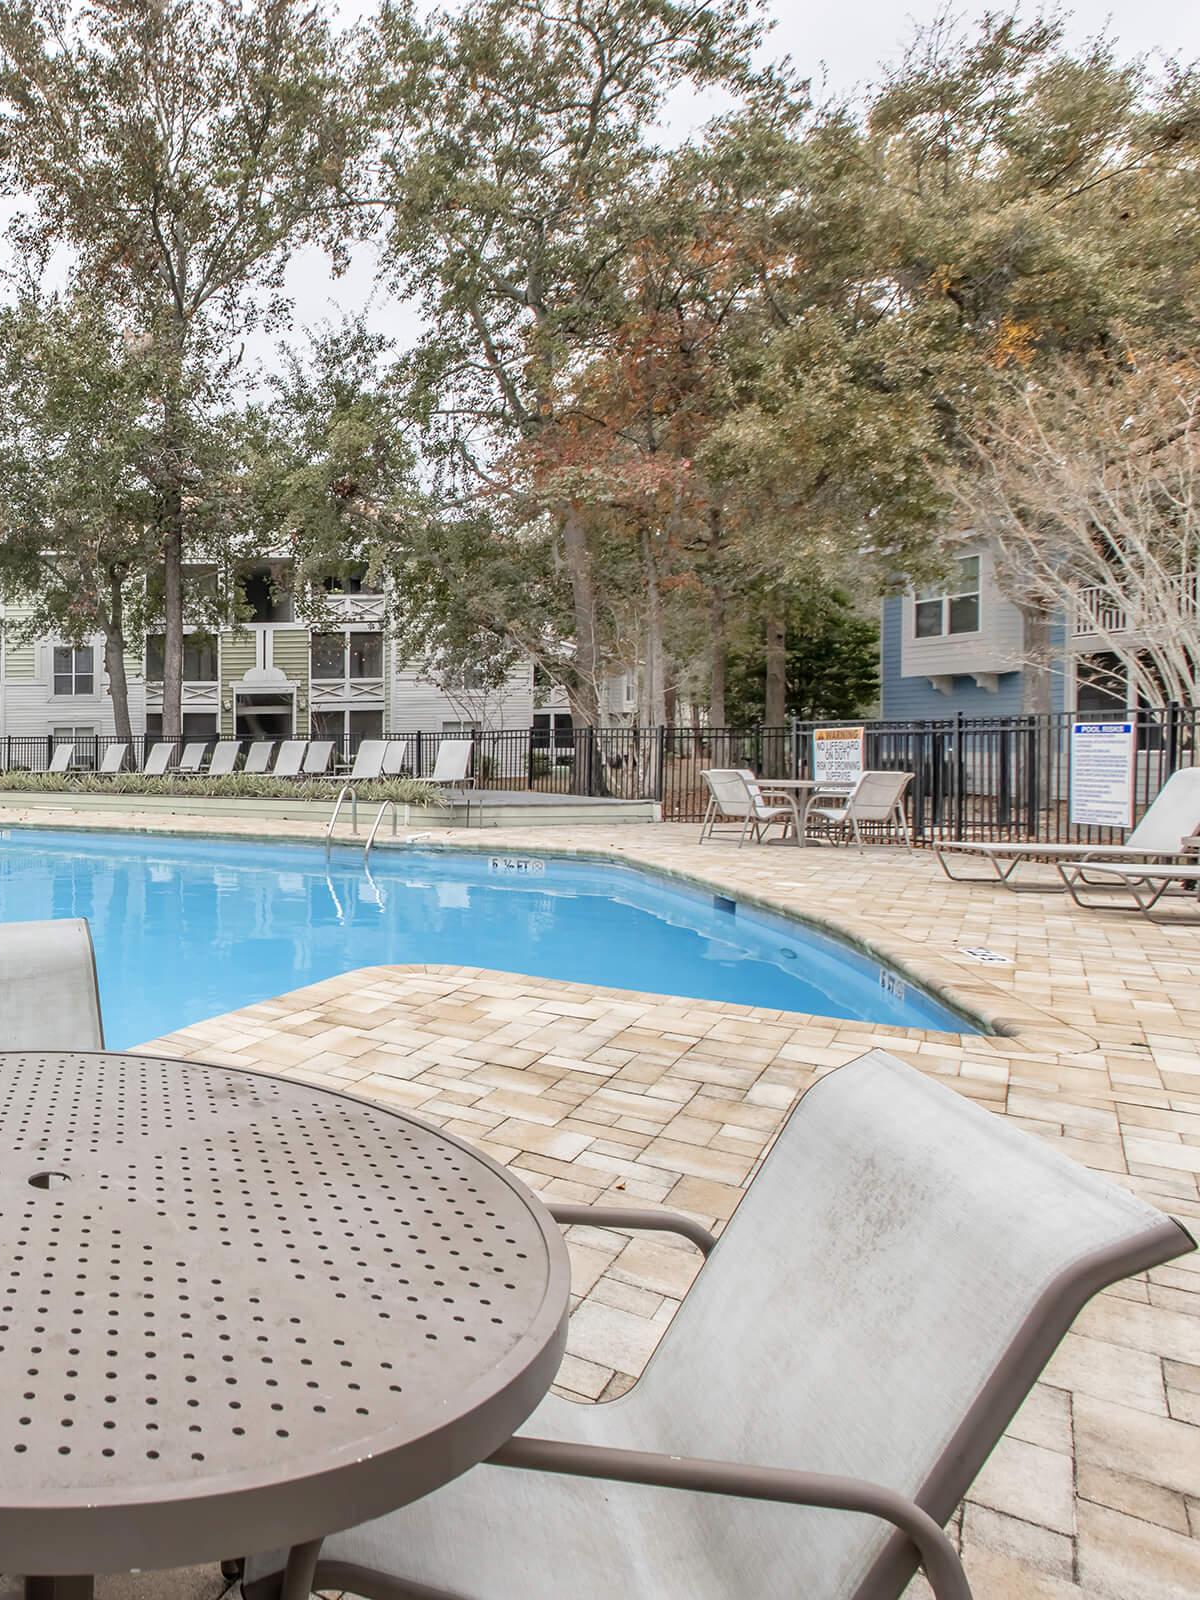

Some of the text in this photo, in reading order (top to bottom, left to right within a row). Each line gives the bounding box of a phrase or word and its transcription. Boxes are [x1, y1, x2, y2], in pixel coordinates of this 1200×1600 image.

[825, 730, 859, 740] WARNING
[1081, 726, 1100, 734] POOL
[816, 740, 860, 752] NO LIFEGUARD
[824, 751, 850, 760] ON DUTY
[816, 761, 860, 771] RISK OF DROWNING
